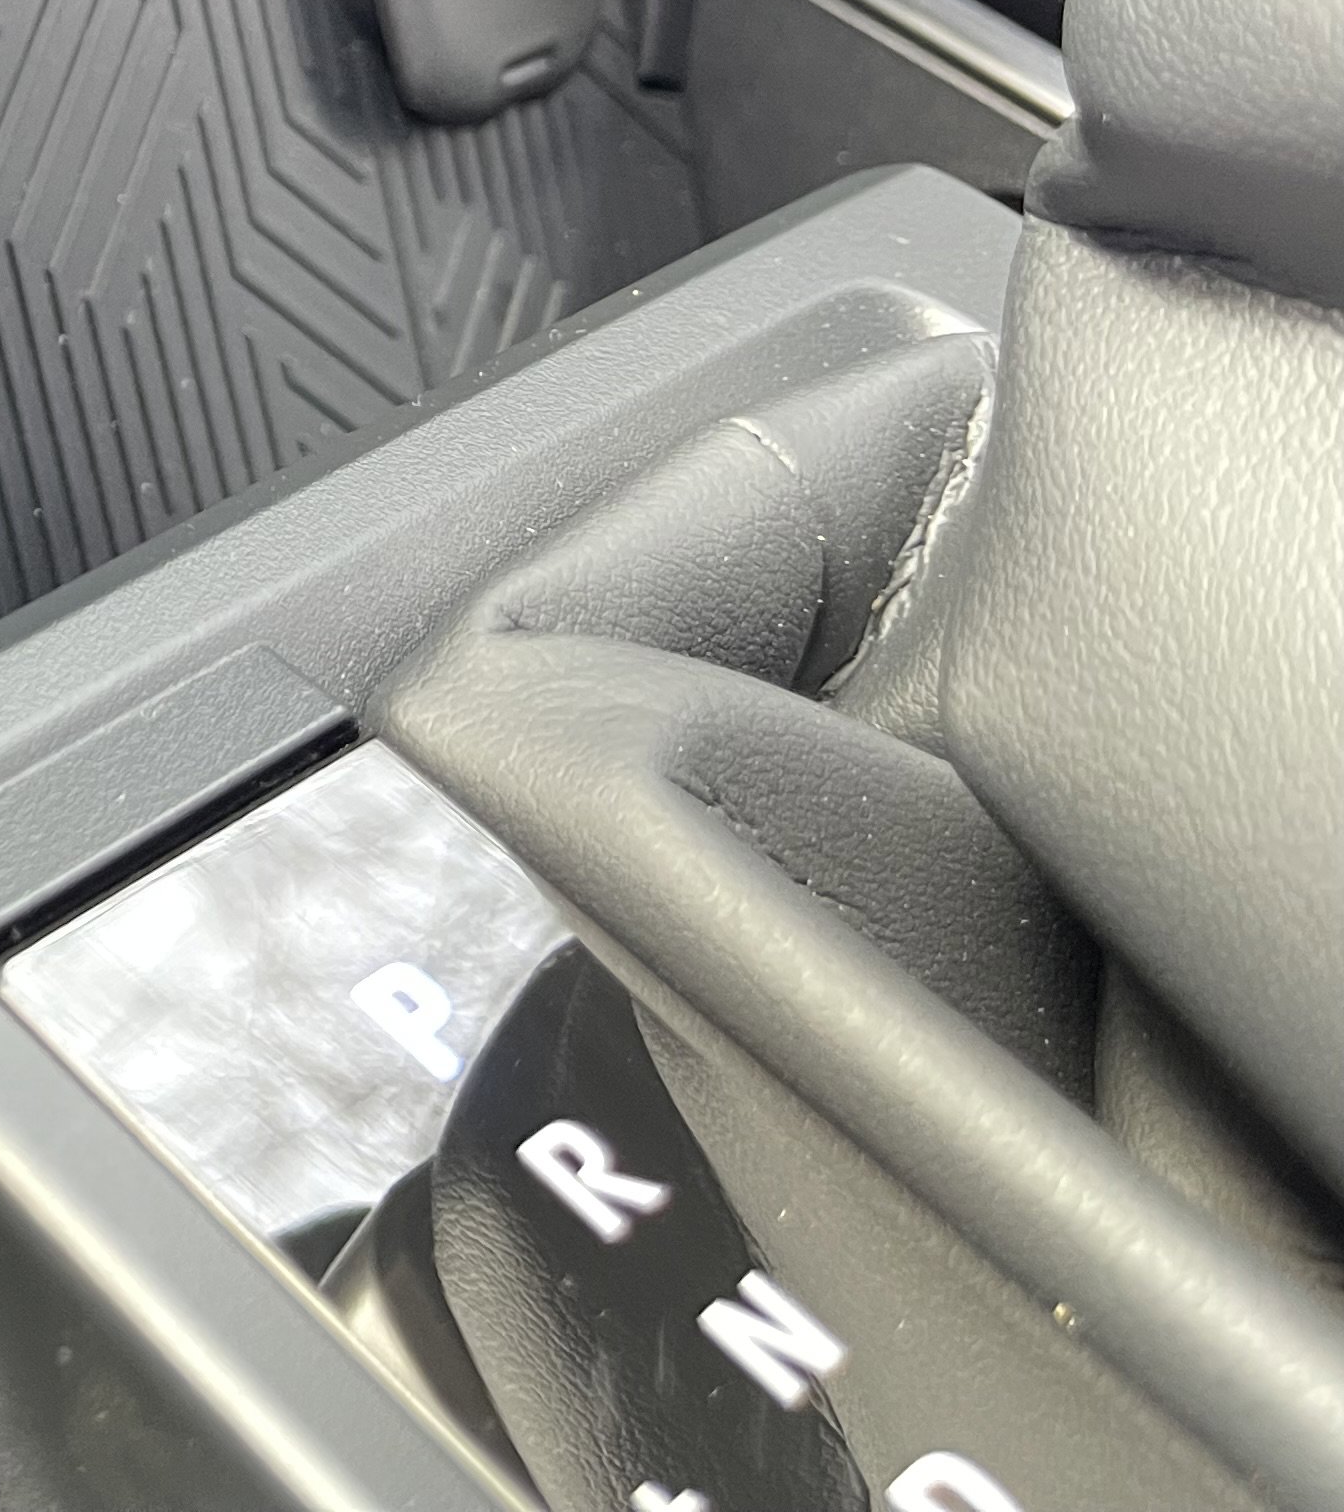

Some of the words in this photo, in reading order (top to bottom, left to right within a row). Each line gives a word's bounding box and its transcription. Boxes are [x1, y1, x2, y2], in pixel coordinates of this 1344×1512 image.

[349, 961, 465, 1082] P
[516, 1118, 672, 1244] R
[698, 1268, 849, 1410] N
